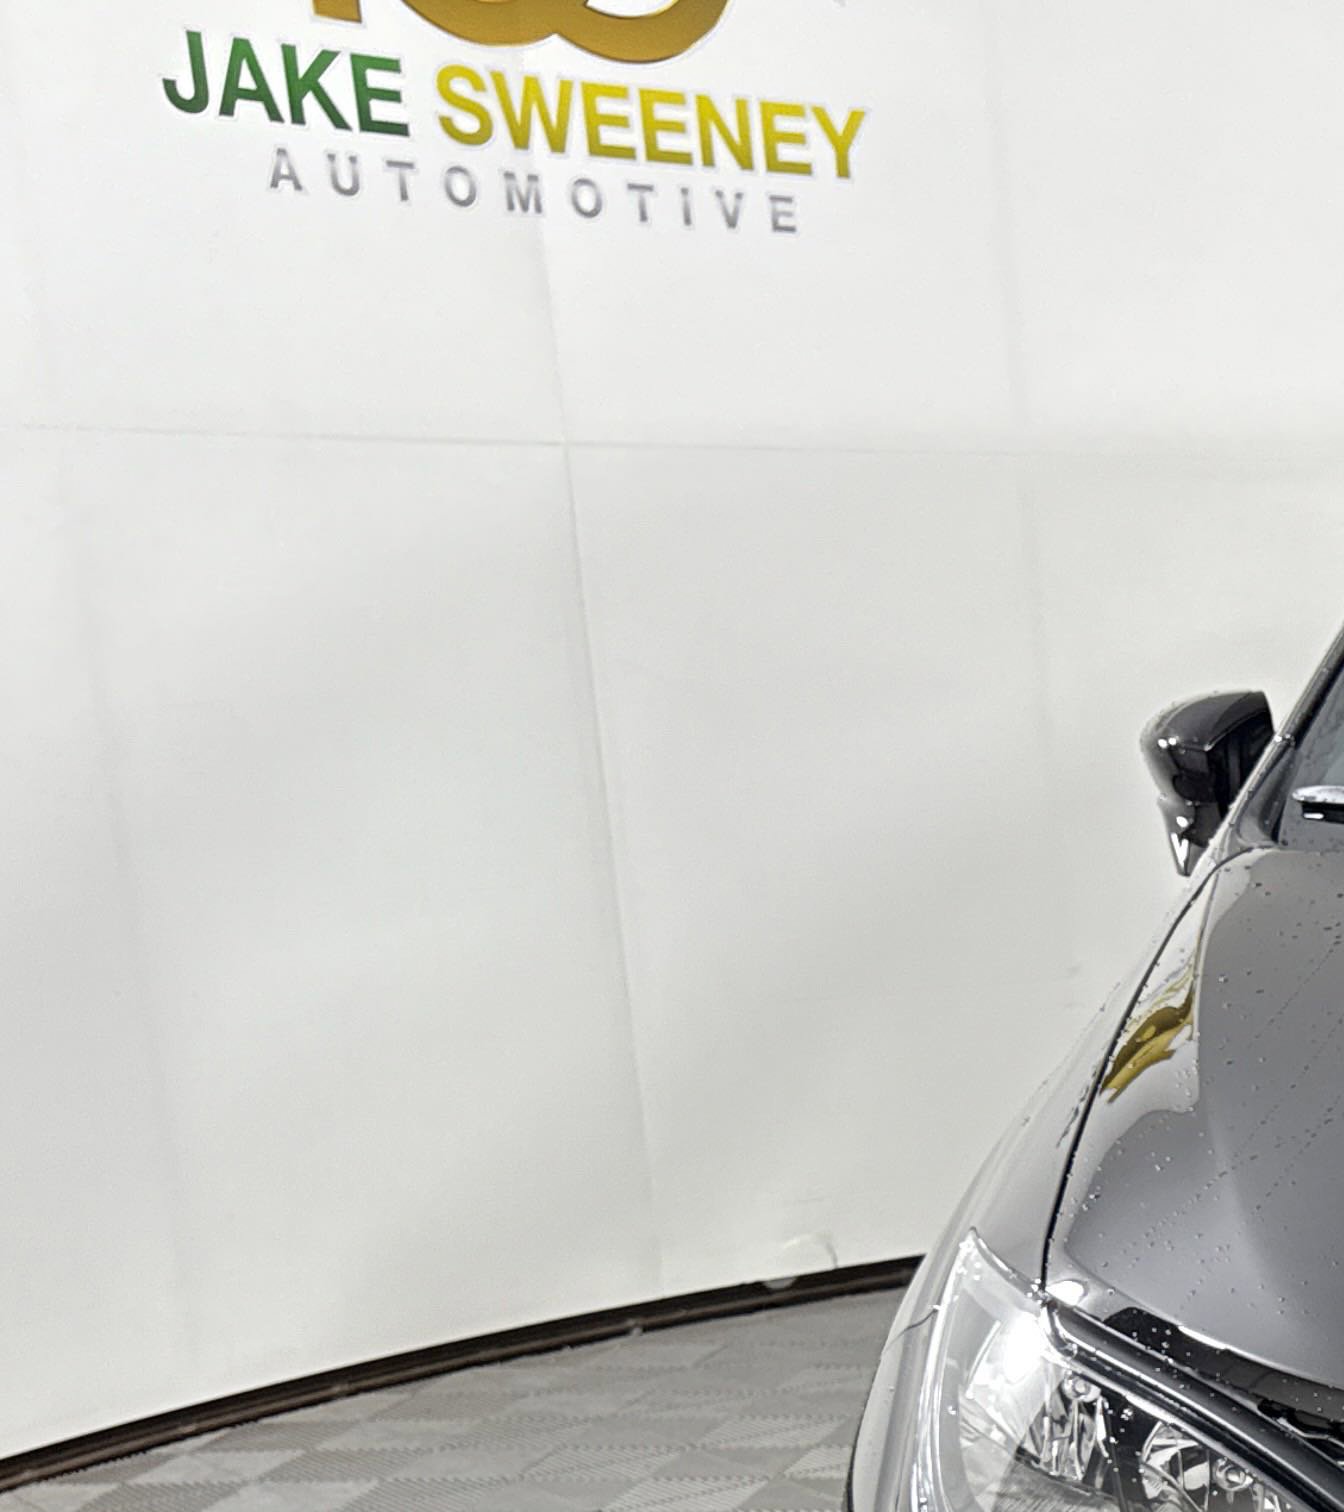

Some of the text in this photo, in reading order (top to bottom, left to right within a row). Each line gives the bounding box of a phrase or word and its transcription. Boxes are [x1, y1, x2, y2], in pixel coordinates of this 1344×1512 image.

[163, 30, 410, 137] JAKE
[436, 64, 865, 180] SWEENEY
[270, 148, 798, 234] AUTOMOTIVE
